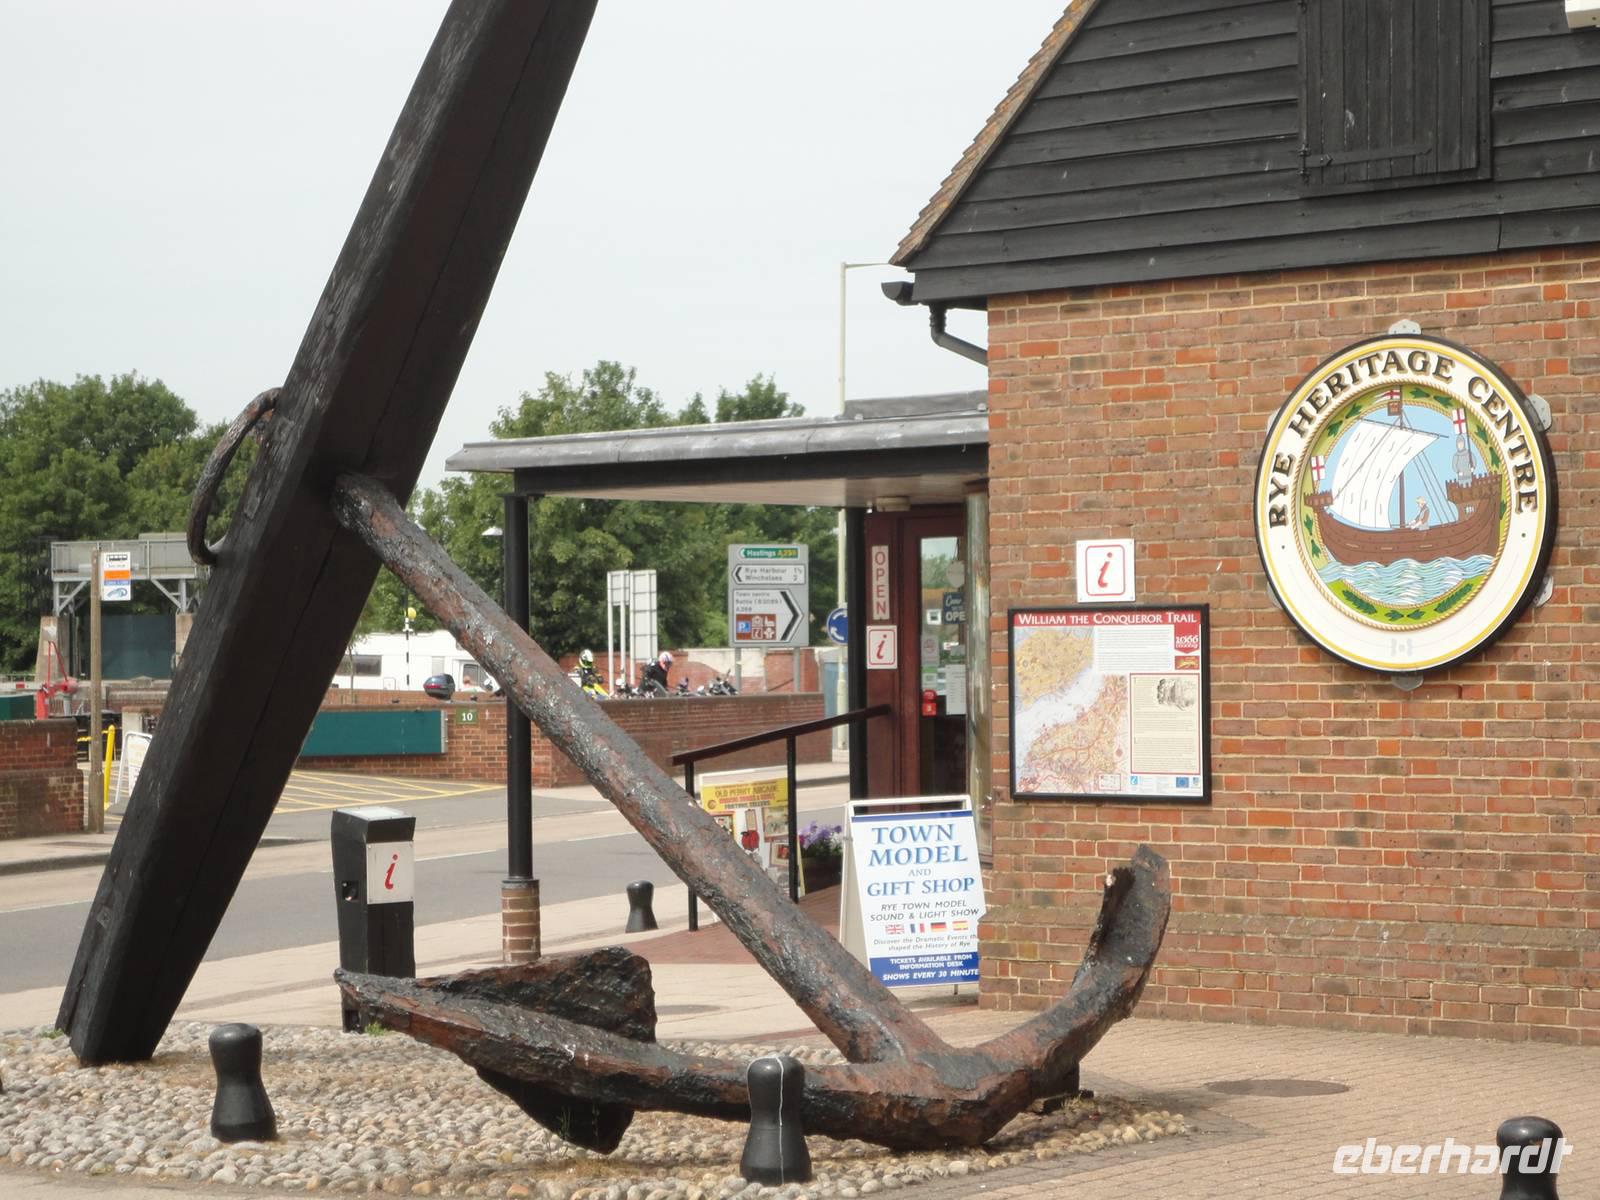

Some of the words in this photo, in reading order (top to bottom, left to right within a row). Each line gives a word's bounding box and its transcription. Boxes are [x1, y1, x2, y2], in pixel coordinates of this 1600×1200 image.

[1268, 451, 1295, 528] RYE
[1288, 350, 1456, 438] HERITAGE
[1467, 375, 1538, 514] CENTRE
[746, 549, 776, 558] Hastings
[874, 551, 886, 615] OPEN
[1018, 613, 1067, 625] WILLIAM
[1070, 615, 1089, 625] THE
[1093, 612, 1163, 625] CONQUEROR
[1166, 611, 1197, 623] TRAIL
[1175, 634, 1199, 644] 1066
[462, 712, 473, 721] 10
[871, 823, 955, 845] TOWN
[868, 845, 969, 867] MODEL
[908, 868, 932, 877] AND
[866, 880, 915, 896] GIFT
[921, 877, 975, 894] SHOP
[881, 903, 898, 911] RYE
[902, 902, 930, 910] TOWN
[935, 900, 967, 908] MODEL
[870, 913, 904, 921] SOUND
[908, 912, 915, 920] &
[919, 910, 947, 919] LIGHT
[951, 909, 979, 917] SHOW
[925, 942, 948, 950] History
[959, 940, 971, 948] Rye
[890, 957, 916, 965] TICKETS
[918, 955, 952, 963] AVAILABLE
[954, 953, 973, 961] FROM
[899, 961, 945, 970] INFORMATION
[947, 960, 964, 968] DESK
[882, 972, 910, 981] SHOWS
[912, 971, 937, 979] EVERY
